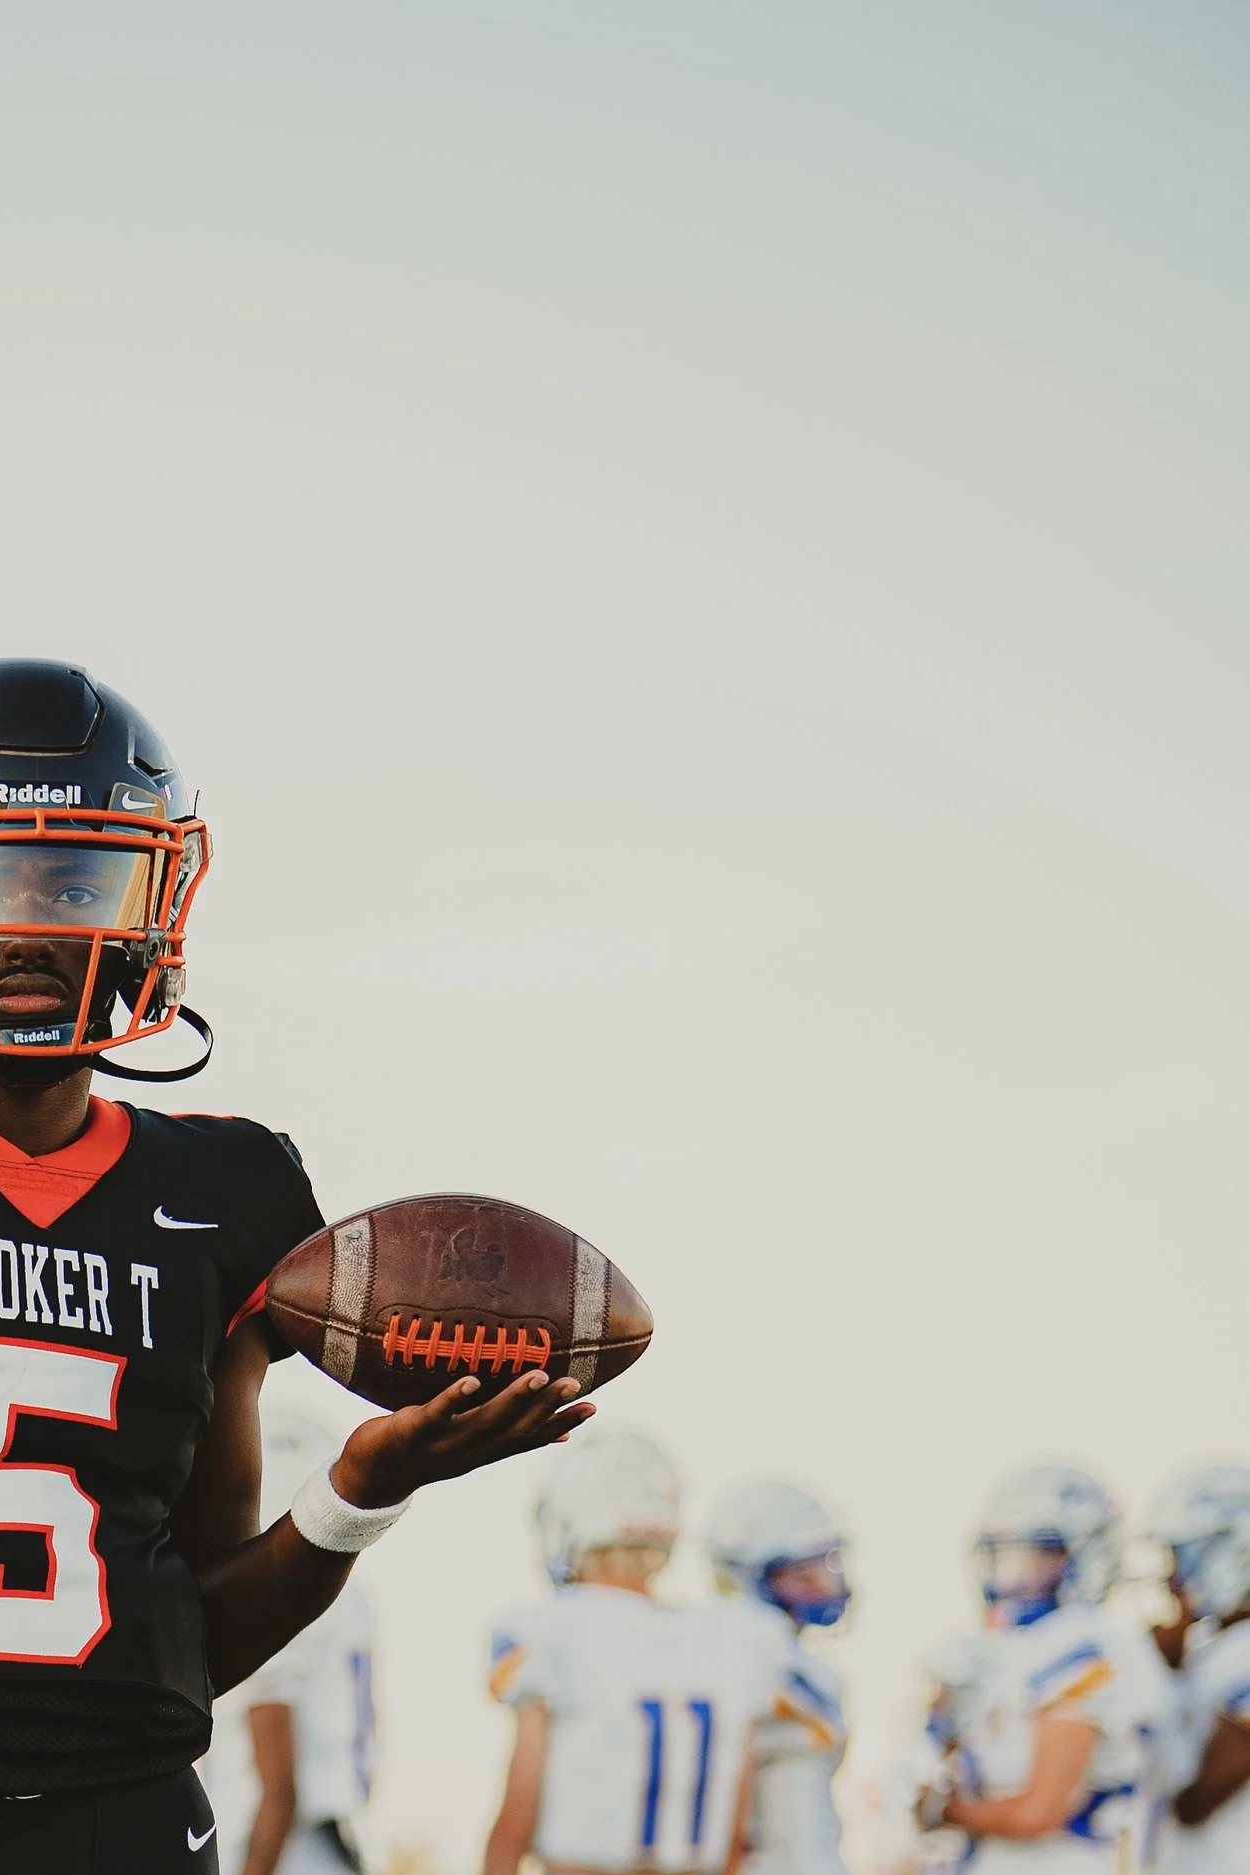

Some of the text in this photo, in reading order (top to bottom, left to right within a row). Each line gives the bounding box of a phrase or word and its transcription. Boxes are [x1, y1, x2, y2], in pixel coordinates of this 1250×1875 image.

[14, 1030, 60, 1044] Riddell
[130, 1263, 159, 1349] T
[639, 1698, 713, 1850] 11
